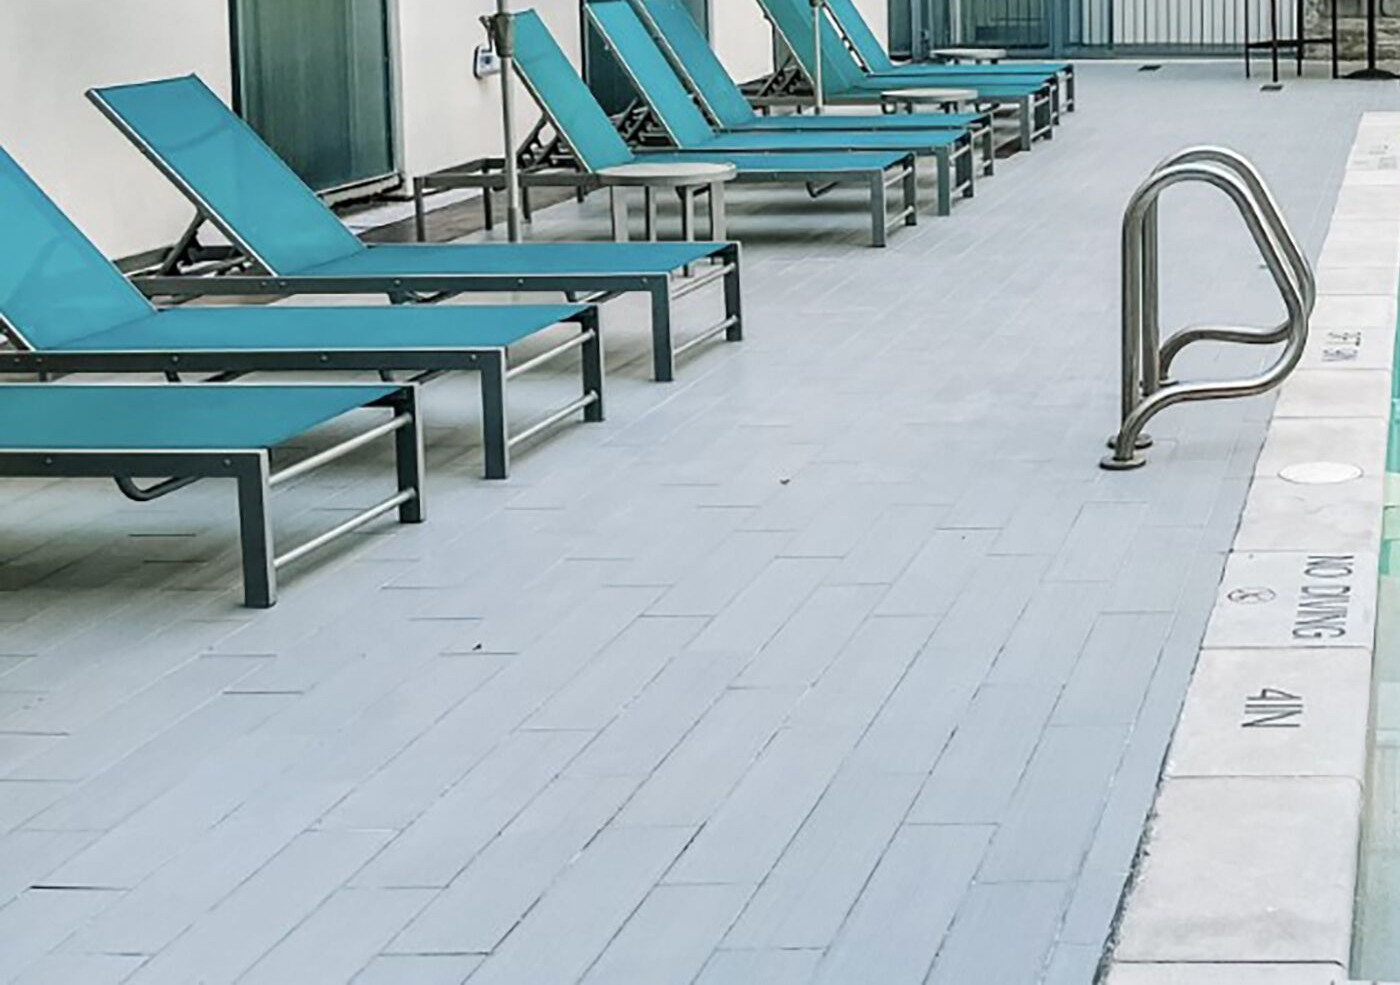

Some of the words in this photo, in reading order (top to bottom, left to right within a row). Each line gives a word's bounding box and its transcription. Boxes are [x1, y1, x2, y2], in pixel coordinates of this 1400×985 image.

[1304, 555, 1355, 579] NO
[1292, 585, 1351, 639] DIVING
[1241, 688, 1304, 728] 4IN
